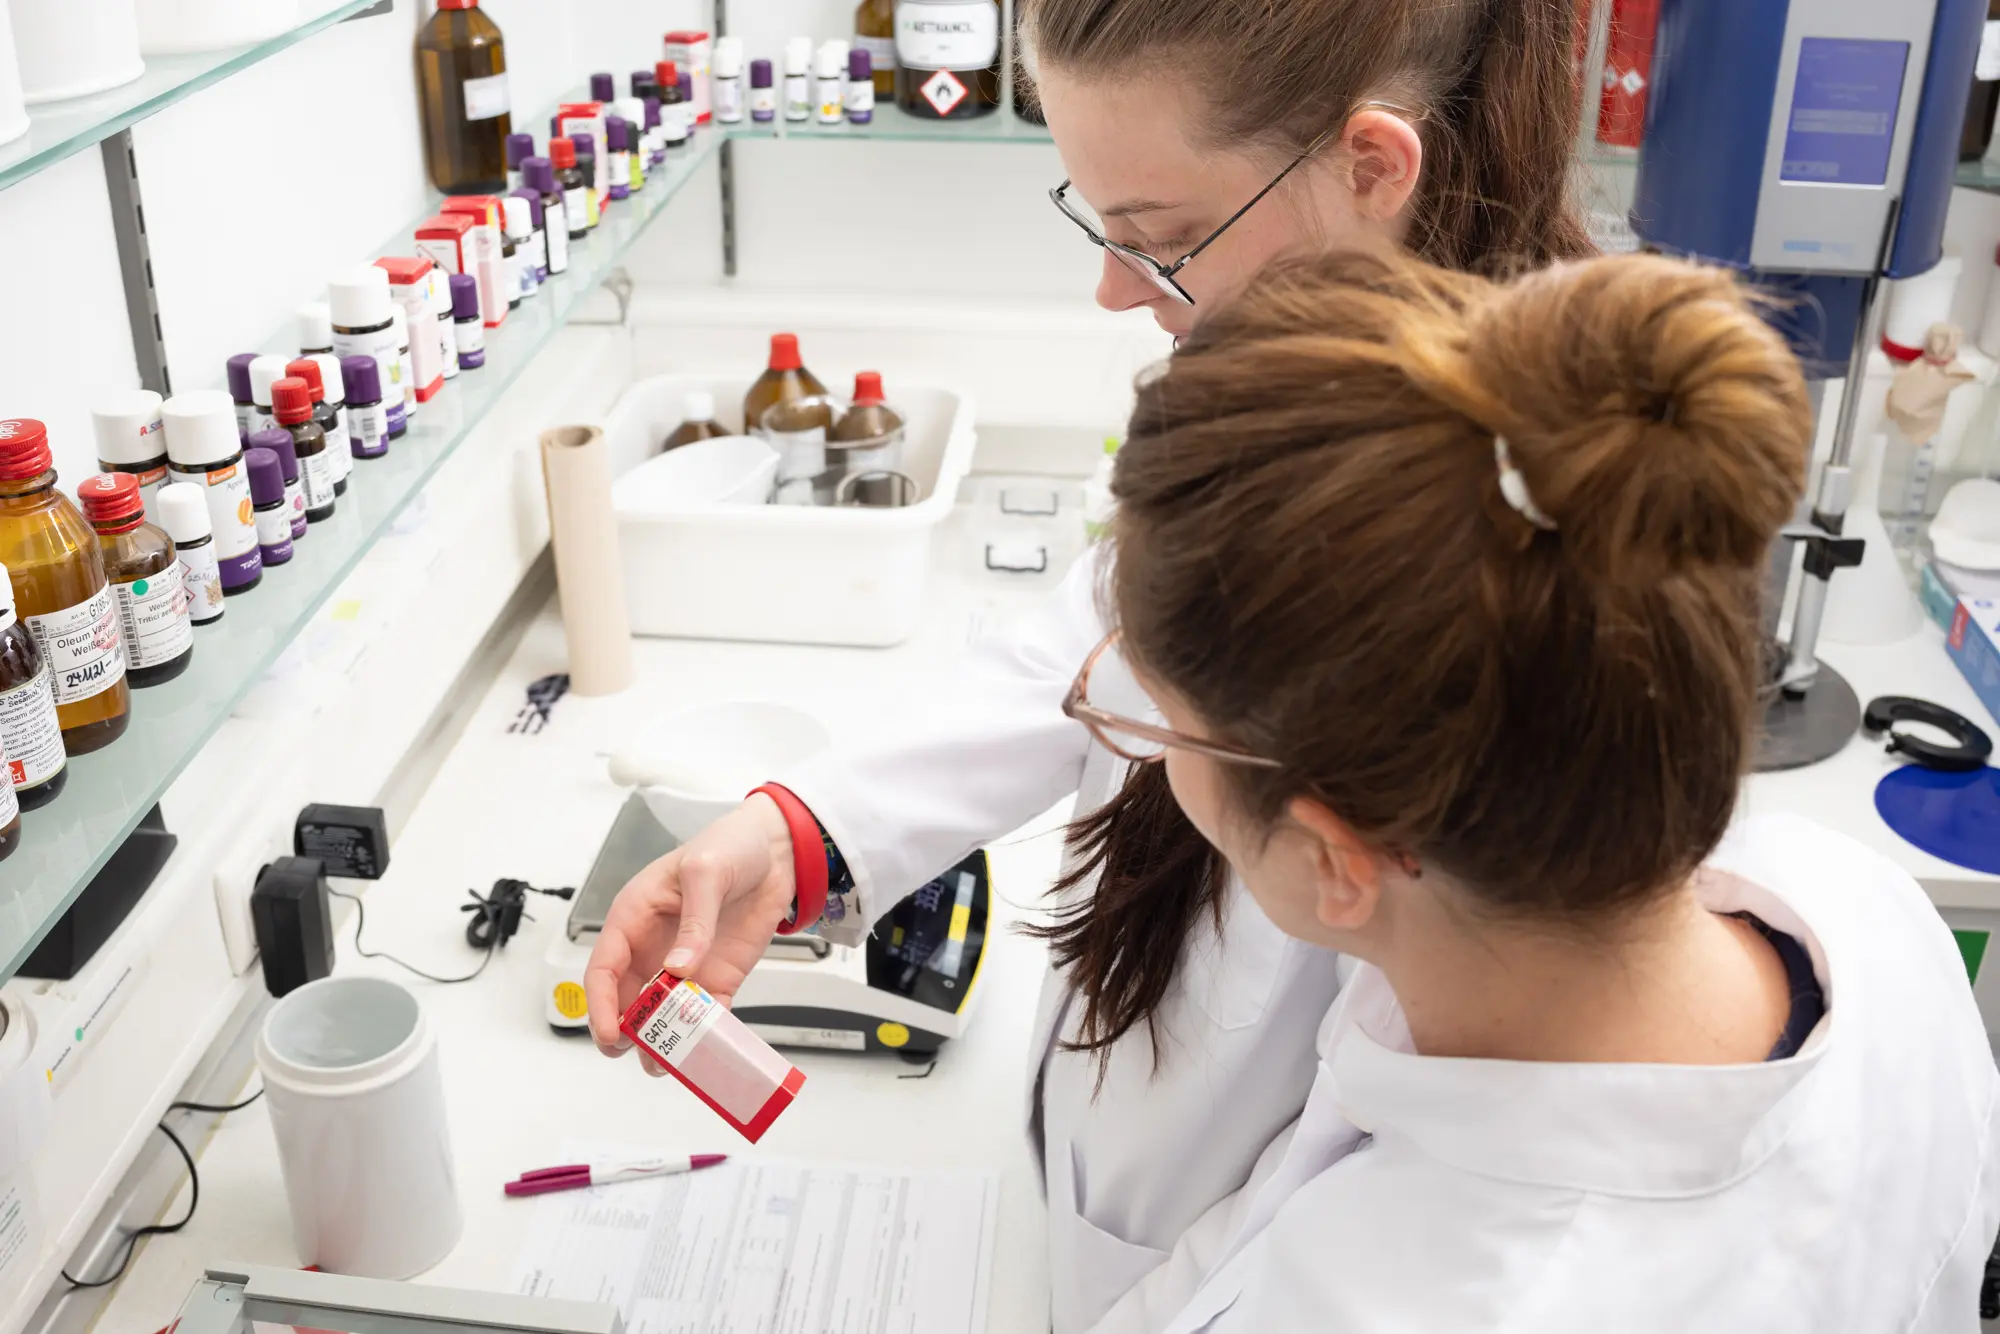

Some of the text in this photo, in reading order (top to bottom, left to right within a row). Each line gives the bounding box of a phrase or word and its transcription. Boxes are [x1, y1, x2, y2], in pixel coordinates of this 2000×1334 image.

[57, 632, 91, 649] Oleum
[71, 637, 105, 657] Weißes
[0, 711, 28, 725] Sesami
[644, 1018, 669, 1045] G470
[658, 1030, 682, 1056] 25ml
